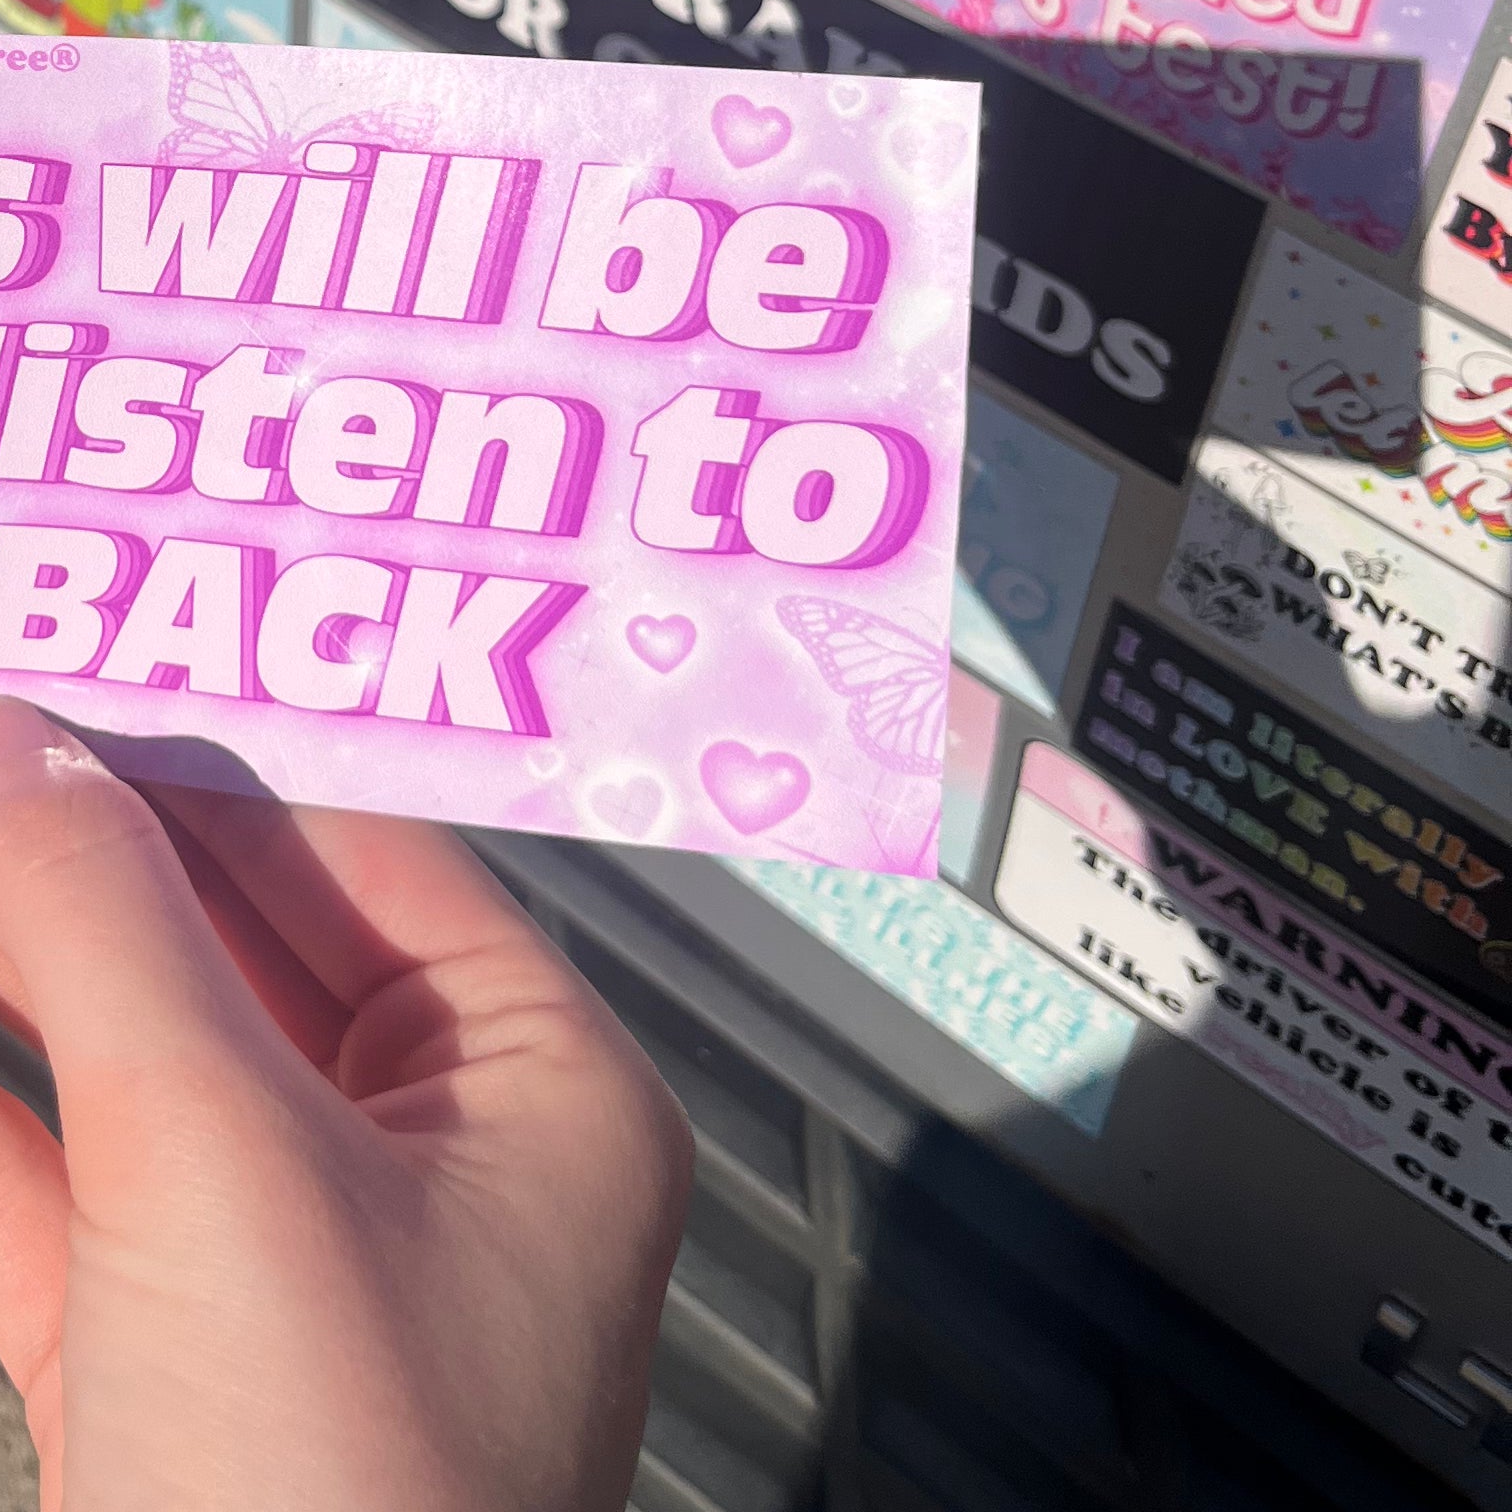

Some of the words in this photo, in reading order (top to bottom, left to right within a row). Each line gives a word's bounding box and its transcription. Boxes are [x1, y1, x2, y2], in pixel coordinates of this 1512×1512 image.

[99, 139, 542, 325] will
[538, 162, 890, 355] be
[630, 384, 931, 570] to
[1272, 584, 1468, 720] WHAT'S
[1285, 544, 1445, 654] DON'T
[1112, 622, 1143, 666] I
[1246, 711, 1505, 890] literally
[1170, 712, 1332, 838] LOVE
[1342, 828, 1489, 941] with
[1071, 833, 1185, 923] The
[1195, 925, 1390, 1063] driver
[1402, 1068, 1476, 1121] of
[1077, 924, 1186, 1016] like
[1144, 820, 1512, 1100] WARNIN
[1184, 953, 1395, 1115] vehicle
[1406, 1109, 1463, 1159] is
